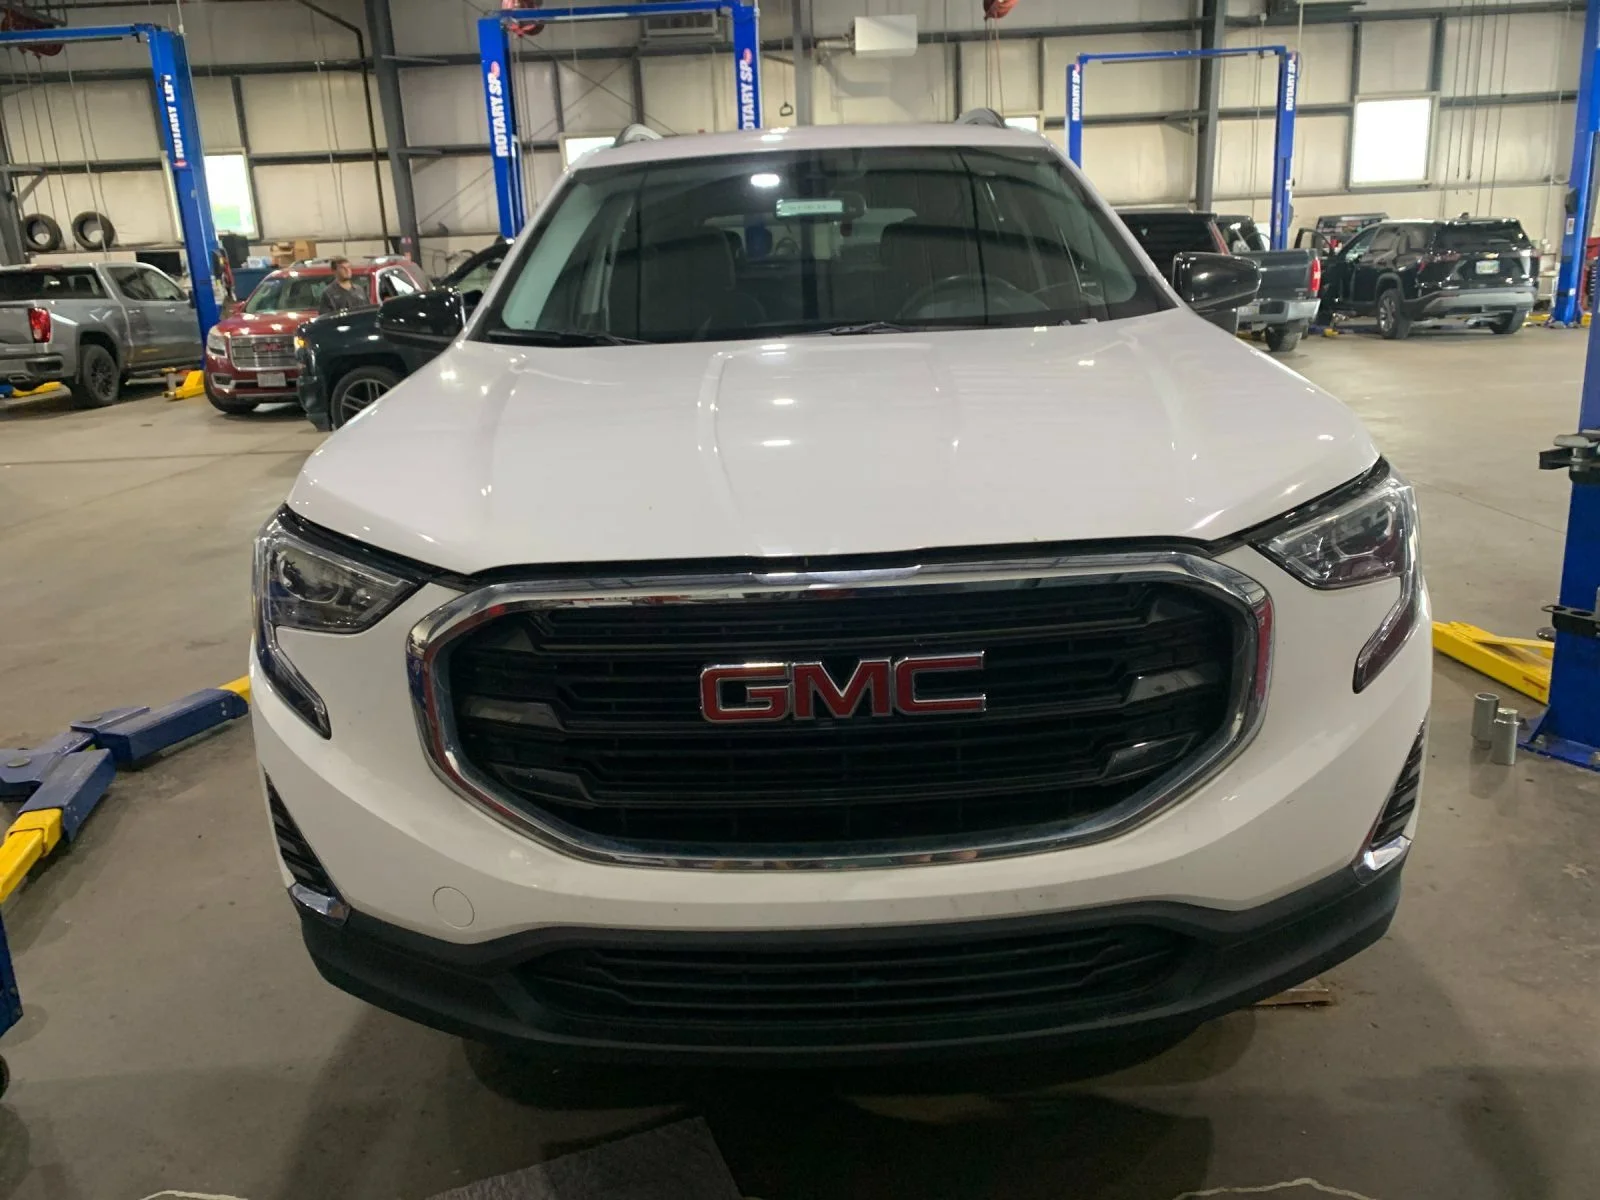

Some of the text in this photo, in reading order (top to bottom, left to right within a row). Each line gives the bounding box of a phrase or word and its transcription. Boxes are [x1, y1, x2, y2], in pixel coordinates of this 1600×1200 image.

[741, 82, 756, 130] OTARY
[1071, 83, 1081, 121] ROTARY
[1285, 73, 1296, 111] ROTARY
[488, 94, 509, 157] ROTARY
[700, 651, 987, 723] GMC
